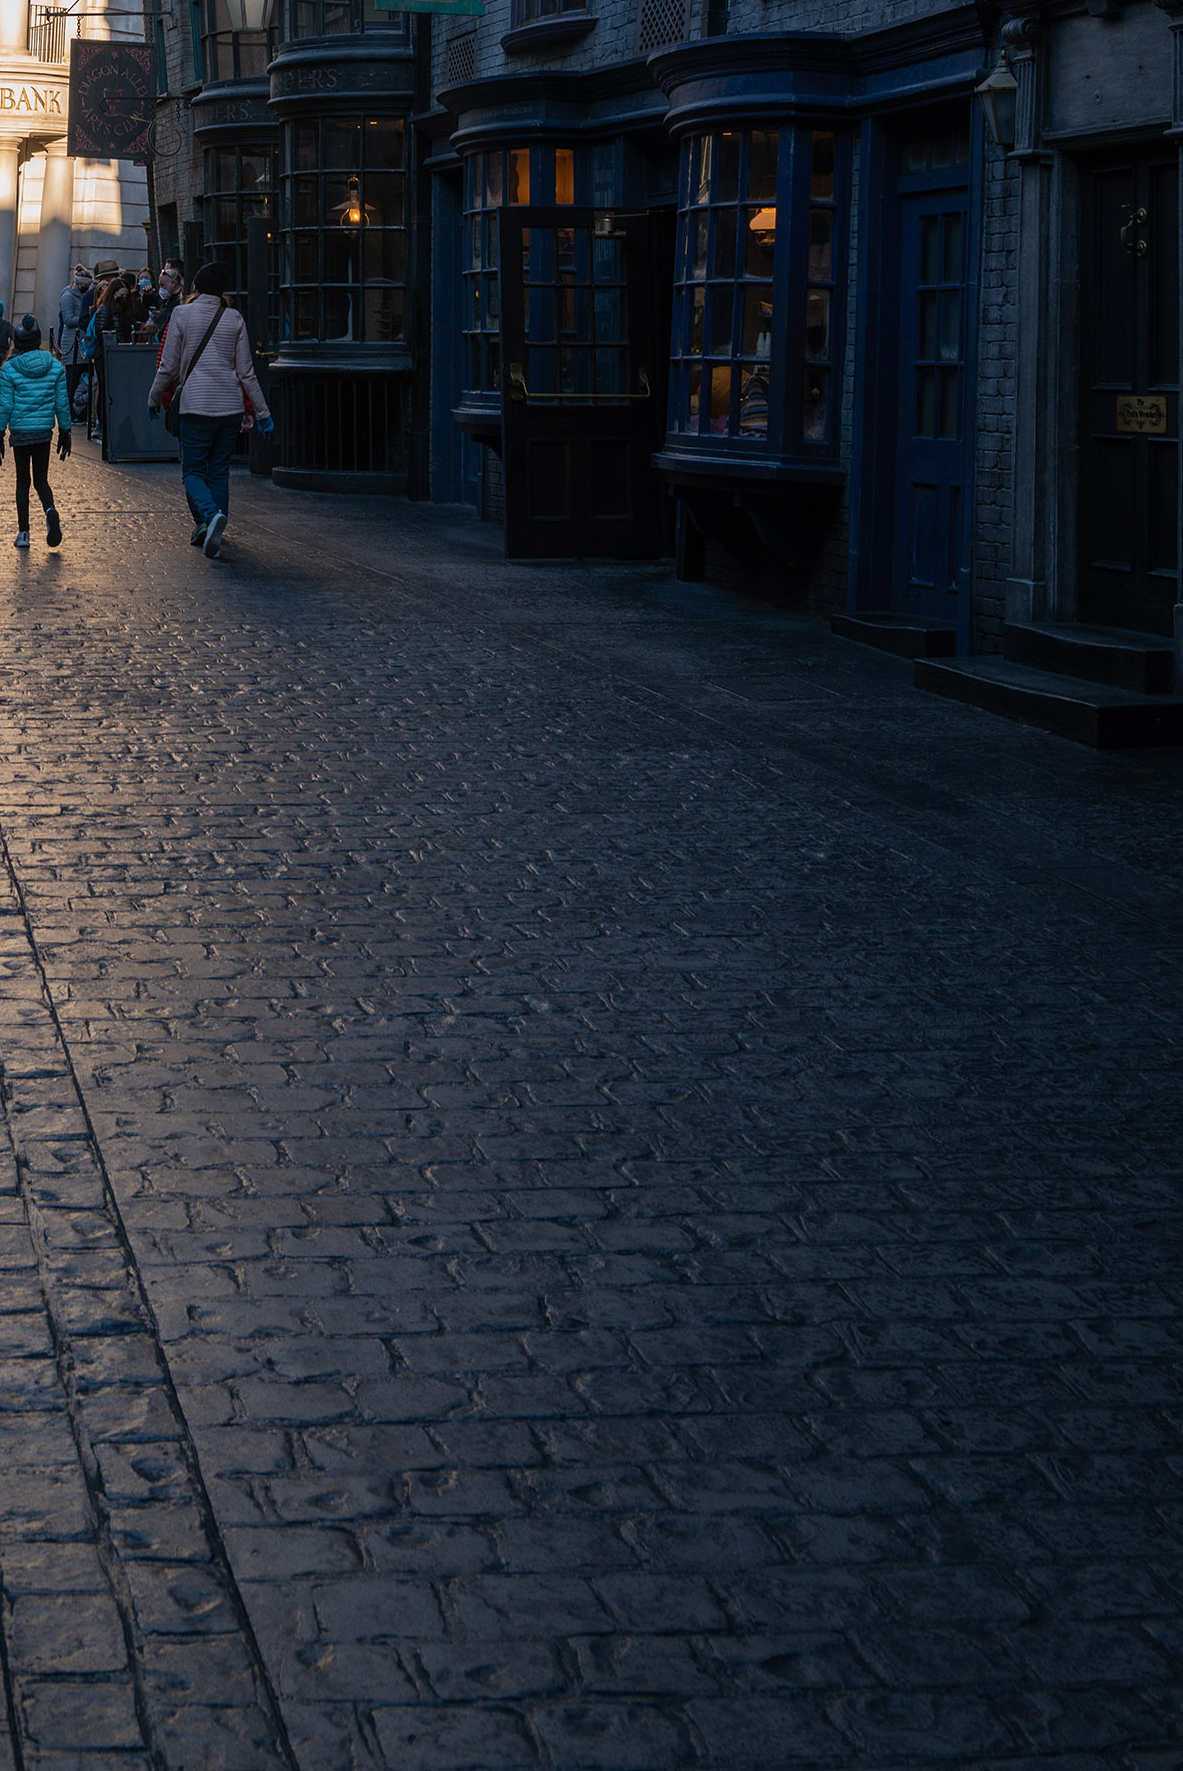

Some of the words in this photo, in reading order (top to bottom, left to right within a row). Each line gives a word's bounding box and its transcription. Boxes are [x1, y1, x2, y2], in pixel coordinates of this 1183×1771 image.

[78, 64, 118, 95] DIAGON
[0, 86, 61, 114] BANK
[82, 108, 112, 135] ARTS
